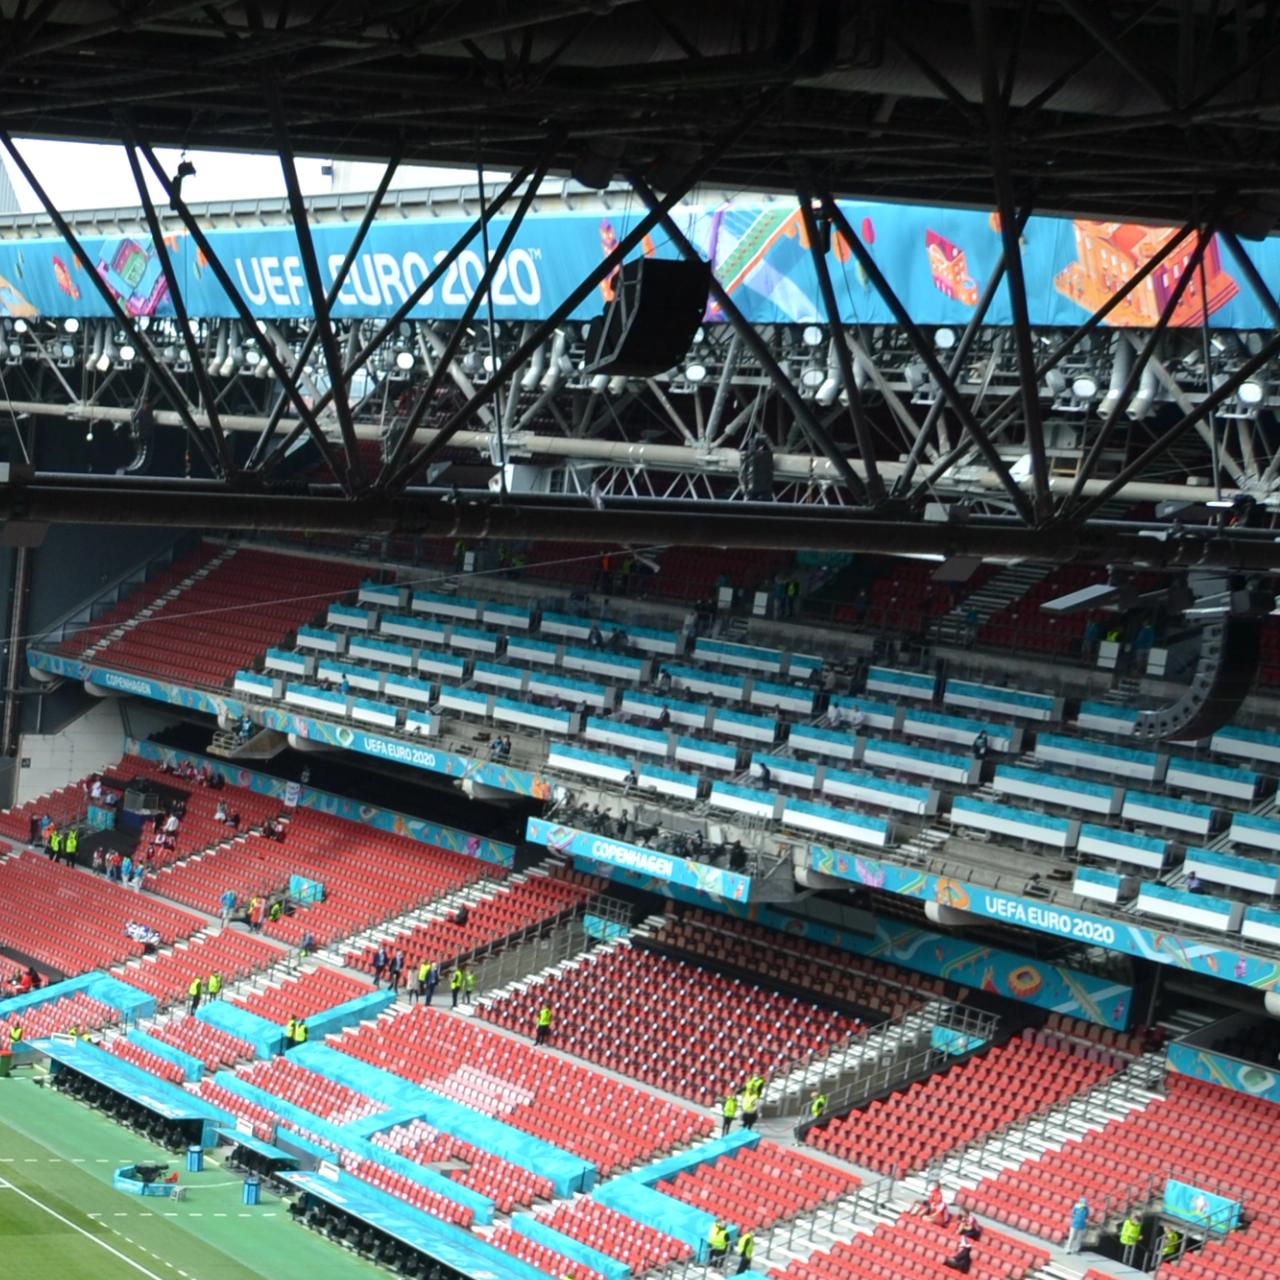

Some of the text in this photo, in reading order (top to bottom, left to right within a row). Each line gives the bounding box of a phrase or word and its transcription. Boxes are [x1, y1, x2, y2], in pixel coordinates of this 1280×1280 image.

[235, 255, 328, 306] UEF
[364, 737, 436, 767] UEFA EURO 2020
[592, 840, 674, 877] COPENHAGEN
[985, 895, 1116, 944] UEFA EURO 2020
